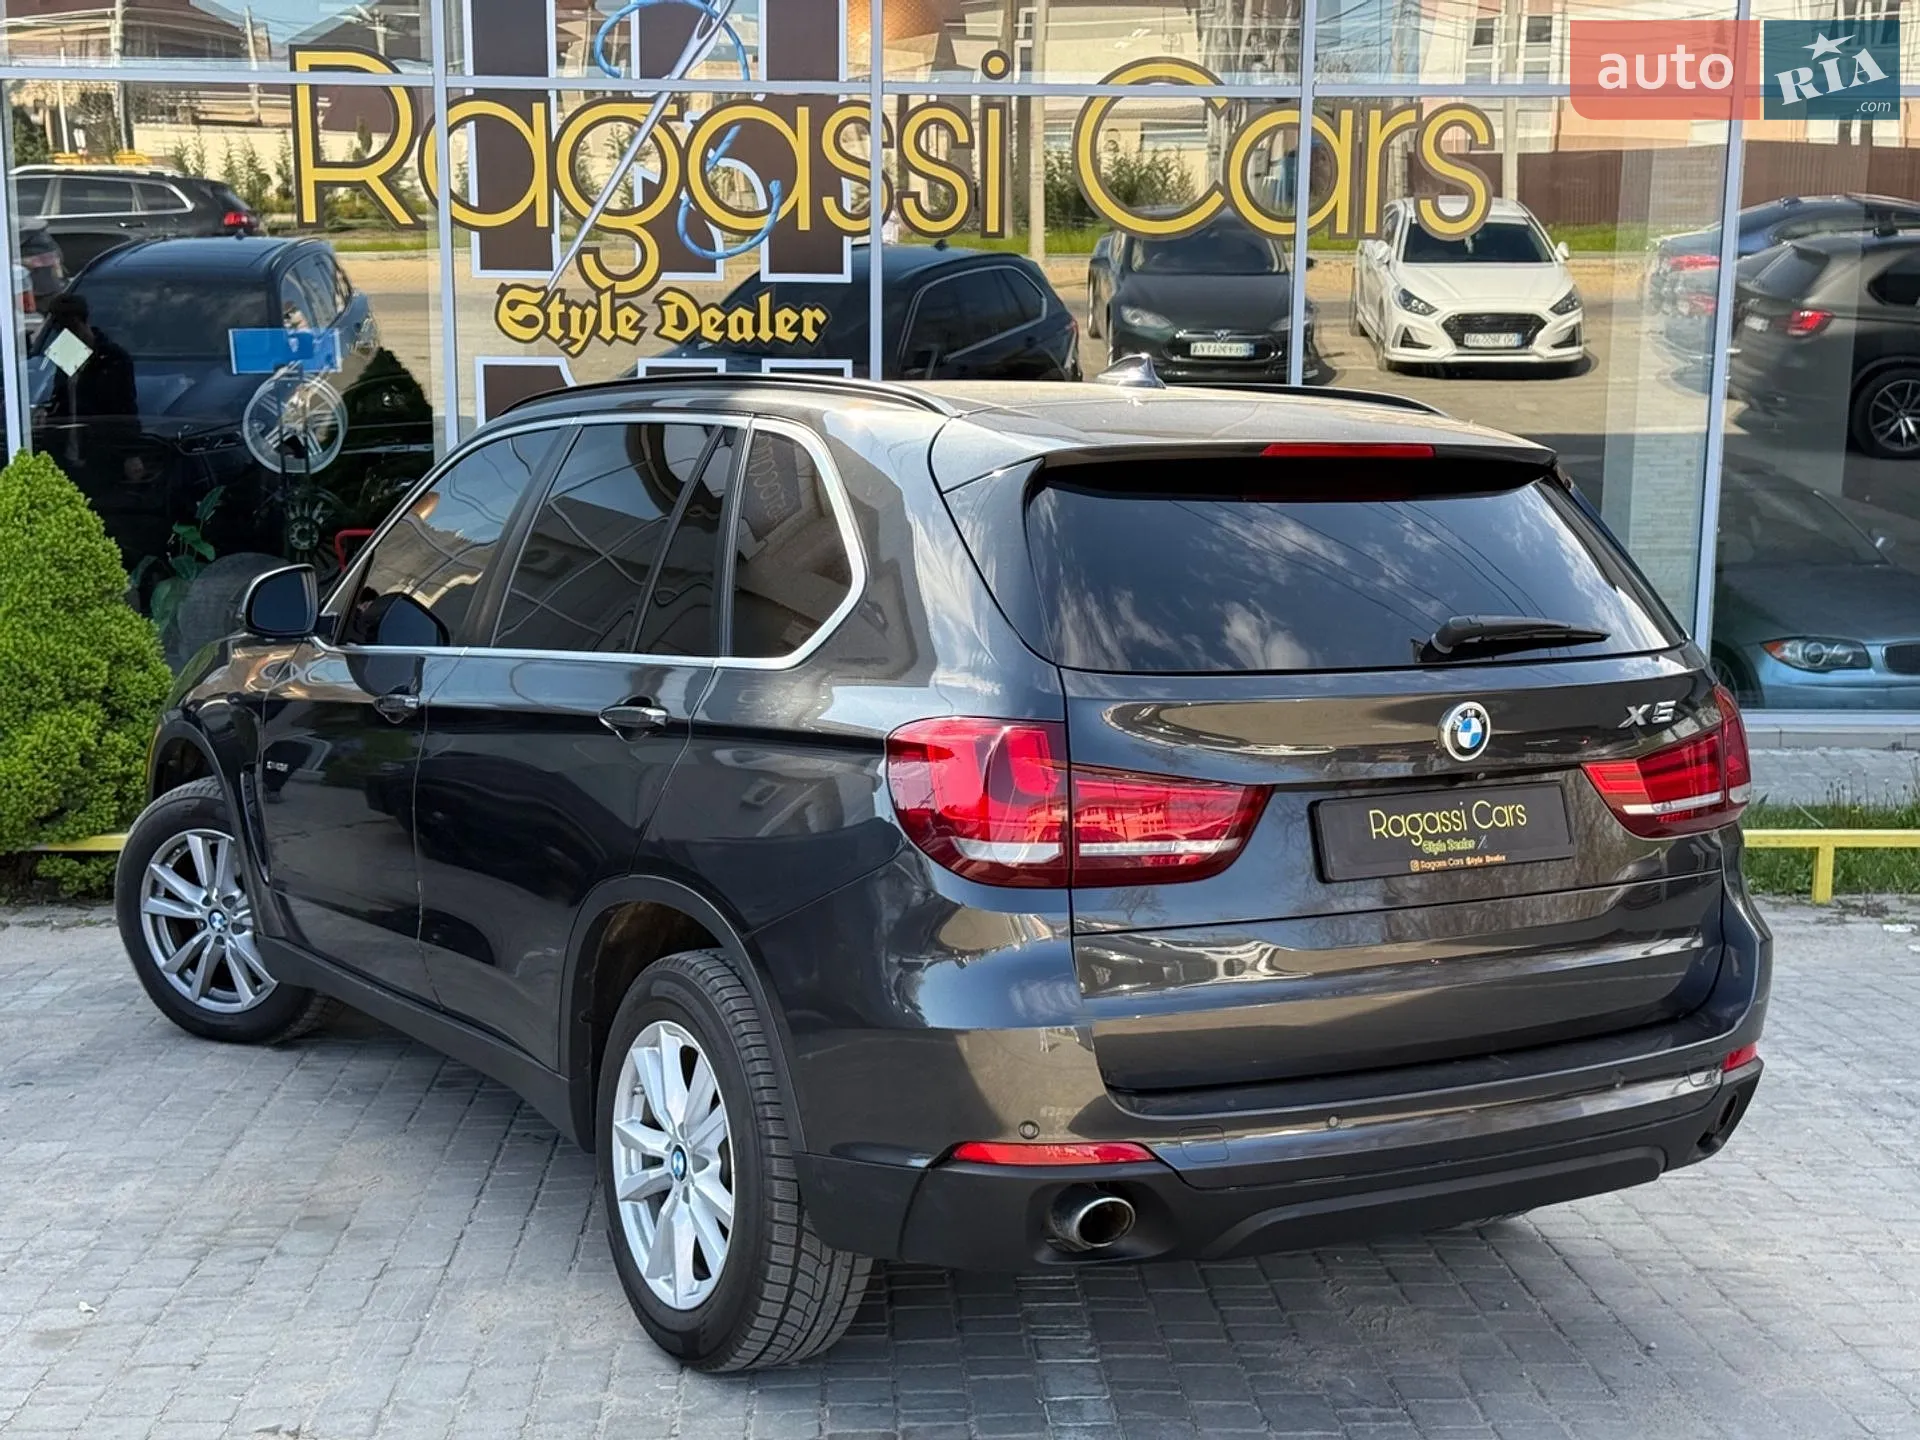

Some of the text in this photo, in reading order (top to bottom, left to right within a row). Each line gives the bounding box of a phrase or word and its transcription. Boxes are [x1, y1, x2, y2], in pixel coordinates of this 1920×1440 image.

[289, 44, 1495, 294] Ragassi Cars
[495, 283, 832, 358] Style Dealer
[1617, 700, 1677, 728] X5
[1369, 800, 1528, 847] Ragassi Cars
